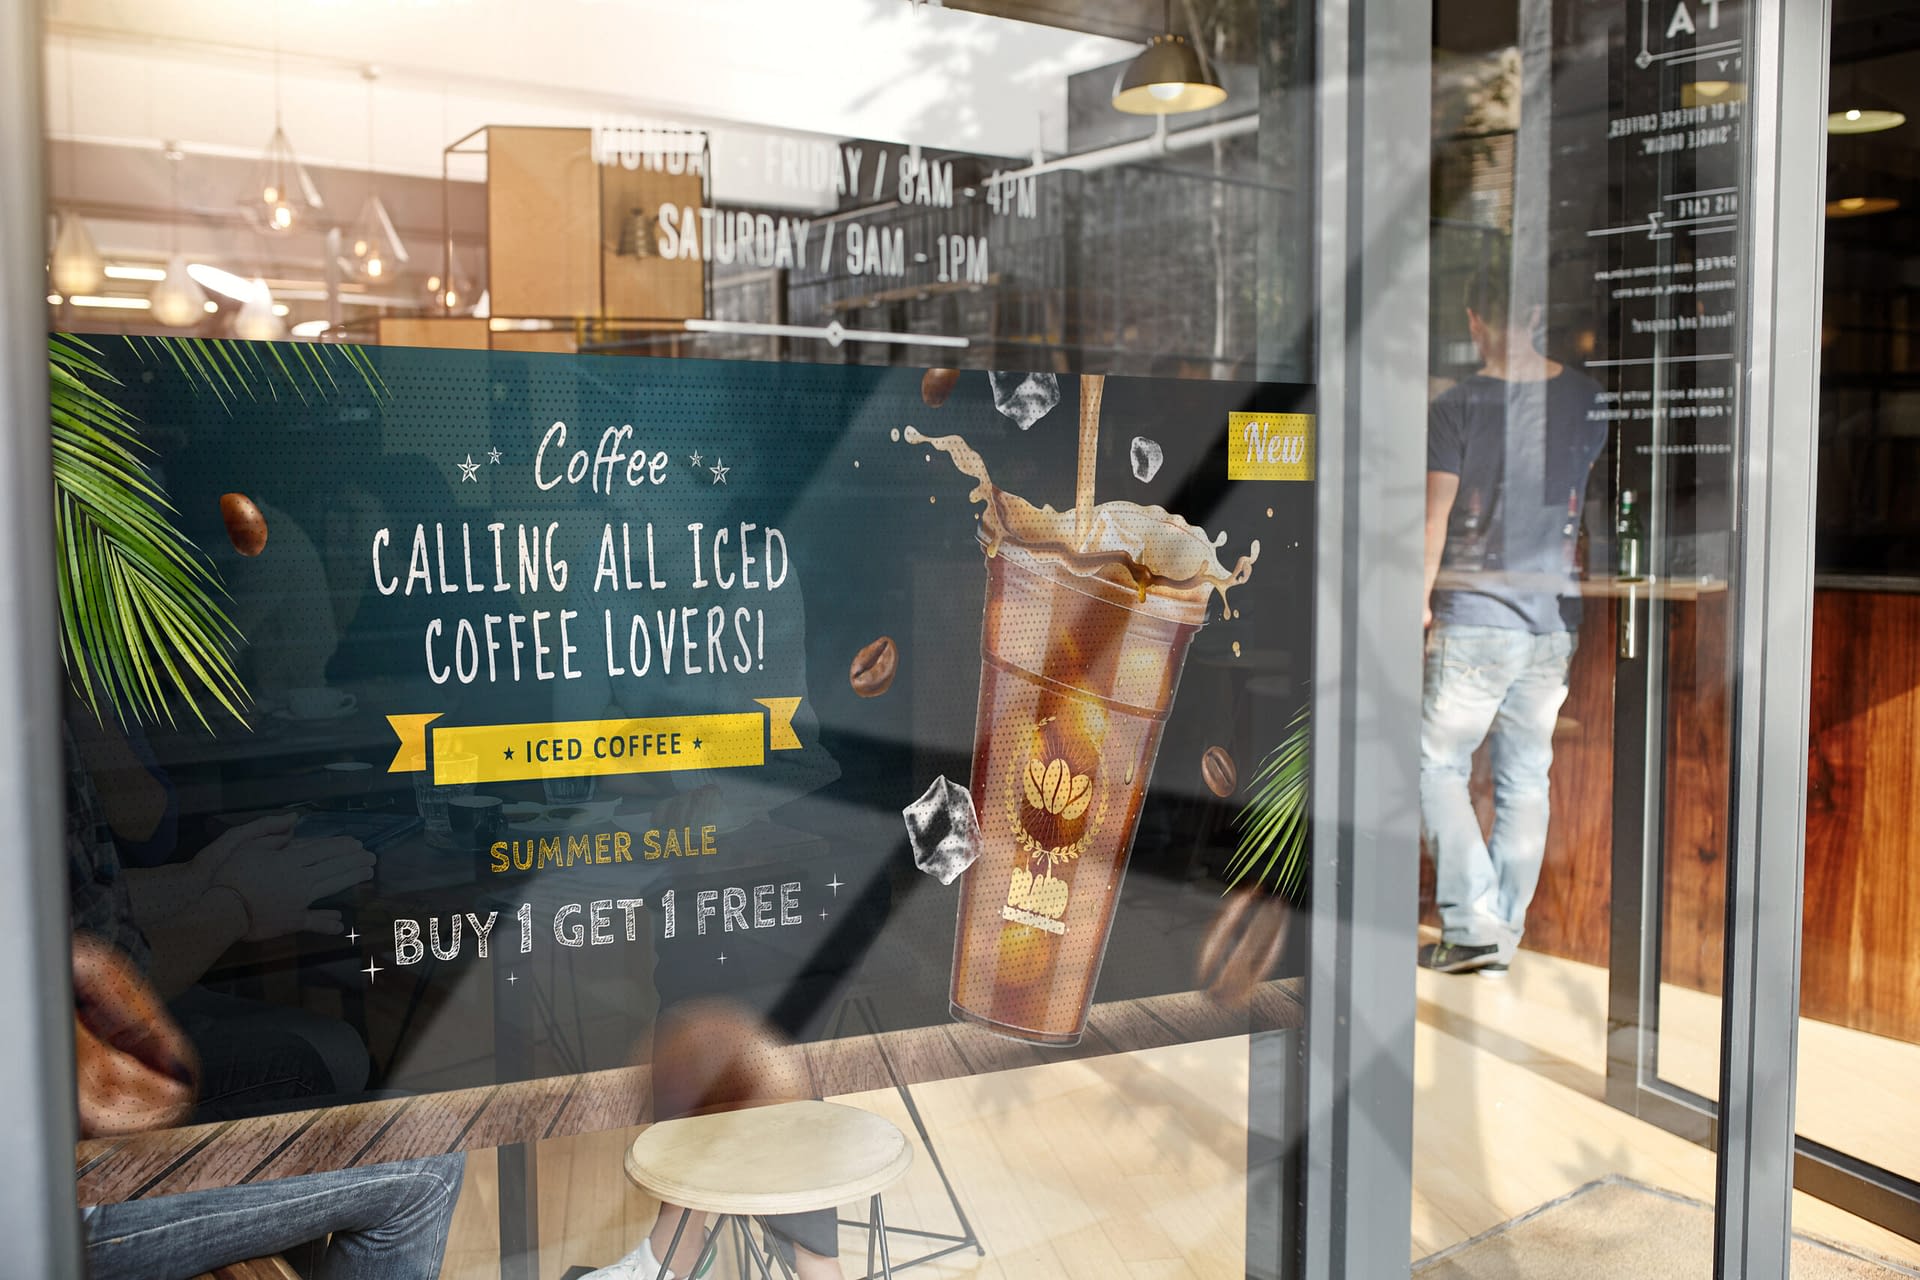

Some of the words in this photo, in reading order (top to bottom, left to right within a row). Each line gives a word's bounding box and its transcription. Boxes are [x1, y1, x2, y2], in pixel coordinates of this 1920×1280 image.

[764, 134, 864, 198] FRIDAY
[899, 152, 954, 209] 8AM
[986, 169, 1037, 220] 4PM
[657, 201, 811, 271] SATURDAY
[846, 222, 905, 277] 9AM
[937, 233, 989, 284] 1PM
[534, 421, 669, 495] Coffee
[1243, 420, 1304, 465] New
[372, 522, 568, 596] CALLING
[594, 522, 667, 593] ALL
[688, 521, 788, 592] ICED
[425, 610, 583, 684] COFFEE
[605, 605, 765, 678] LOVERS!
[526, 736, 583, 763] ICED
[593, 732, 682, 759] COFFEE
[490, 831, 633, 873] SUMMER
[644, 824, 718, 861] SALE
[394, 911, 498, 966] BUY
[517, 903, 533, 953] 1
[553, 898, 644, 948] GET
[661, 889, 676, 939] 1
[697, 881, 803, 936] FREE
